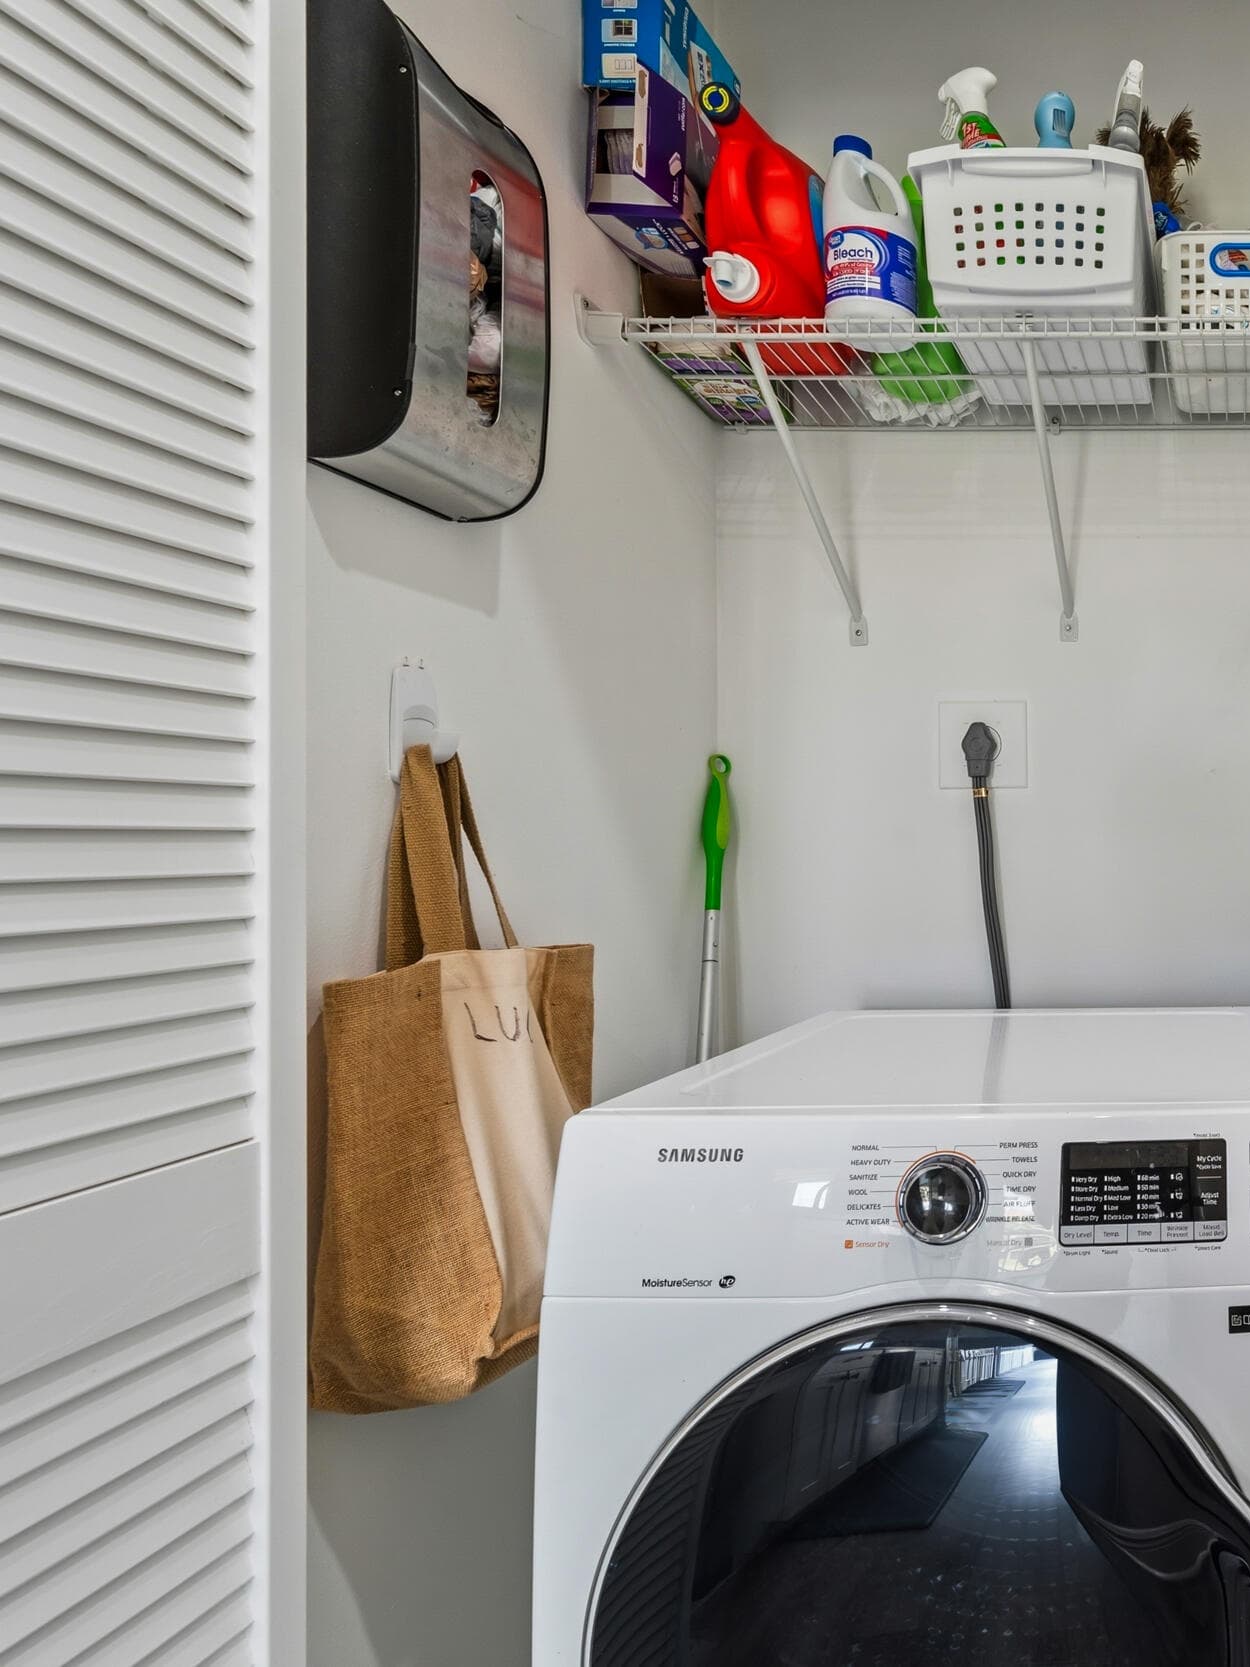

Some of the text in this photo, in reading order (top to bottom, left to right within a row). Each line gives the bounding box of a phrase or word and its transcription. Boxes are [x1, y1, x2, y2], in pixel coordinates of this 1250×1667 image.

[833, 247, 873, 260] Bleach
[657, 1148, 744, 1162] SAMSUNG
[1108, 1175, 1121, 1183] High
[877, 1240, 890, 1248] Dry
[641, 1278, 713, 1288] MoistureSensor
